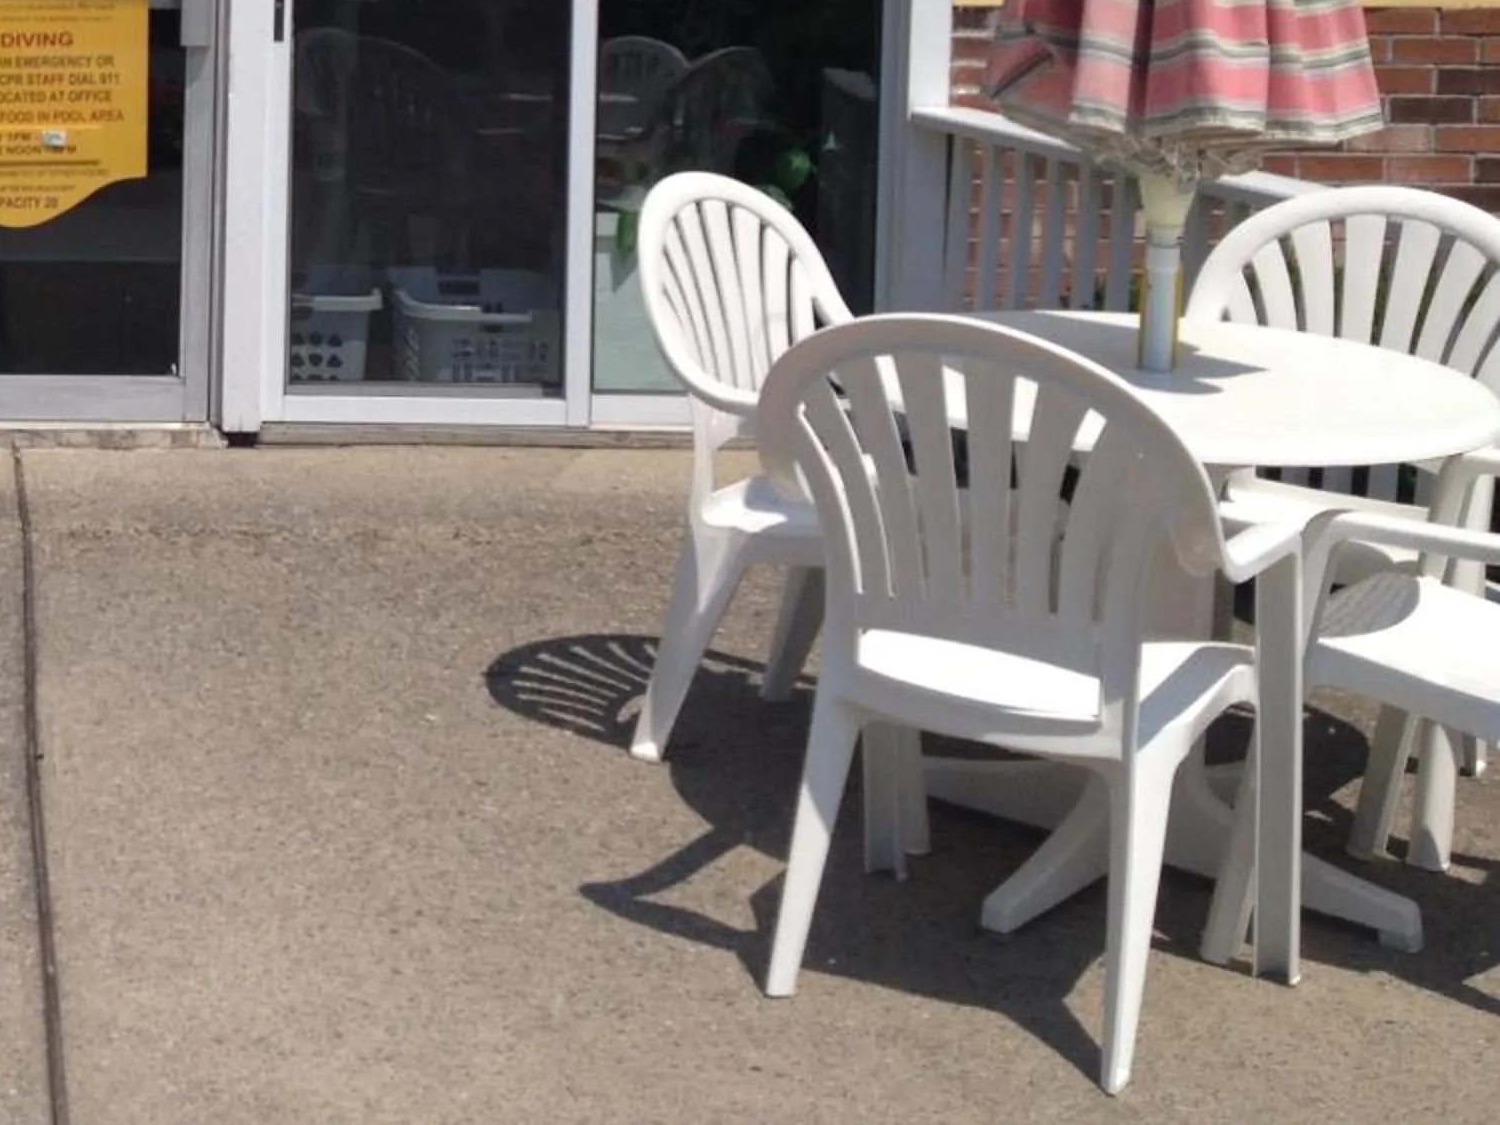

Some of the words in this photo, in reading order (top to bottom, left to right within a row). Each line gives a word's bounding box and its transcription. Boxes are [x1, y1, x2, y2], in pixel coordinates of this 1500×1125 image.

[0, 31, 75, 48] DIVING
[15, 55, 93, 68] EMERGENCY
[95, 54, 116, 68] OR
[27, 73, 65, 87] STAFF
[67, 72, 97, 86] DIAL
[98, 73, 121, 86] 911
[49, 90, 66, 103] AT
[67, 90, 113, 103] OFFICE
[0, 111, 35, 123] FOOD
[37, 110, 51, 123] IN
[52, 110, 87, 123] POOL
[88, 108, 125, 122] AREA
